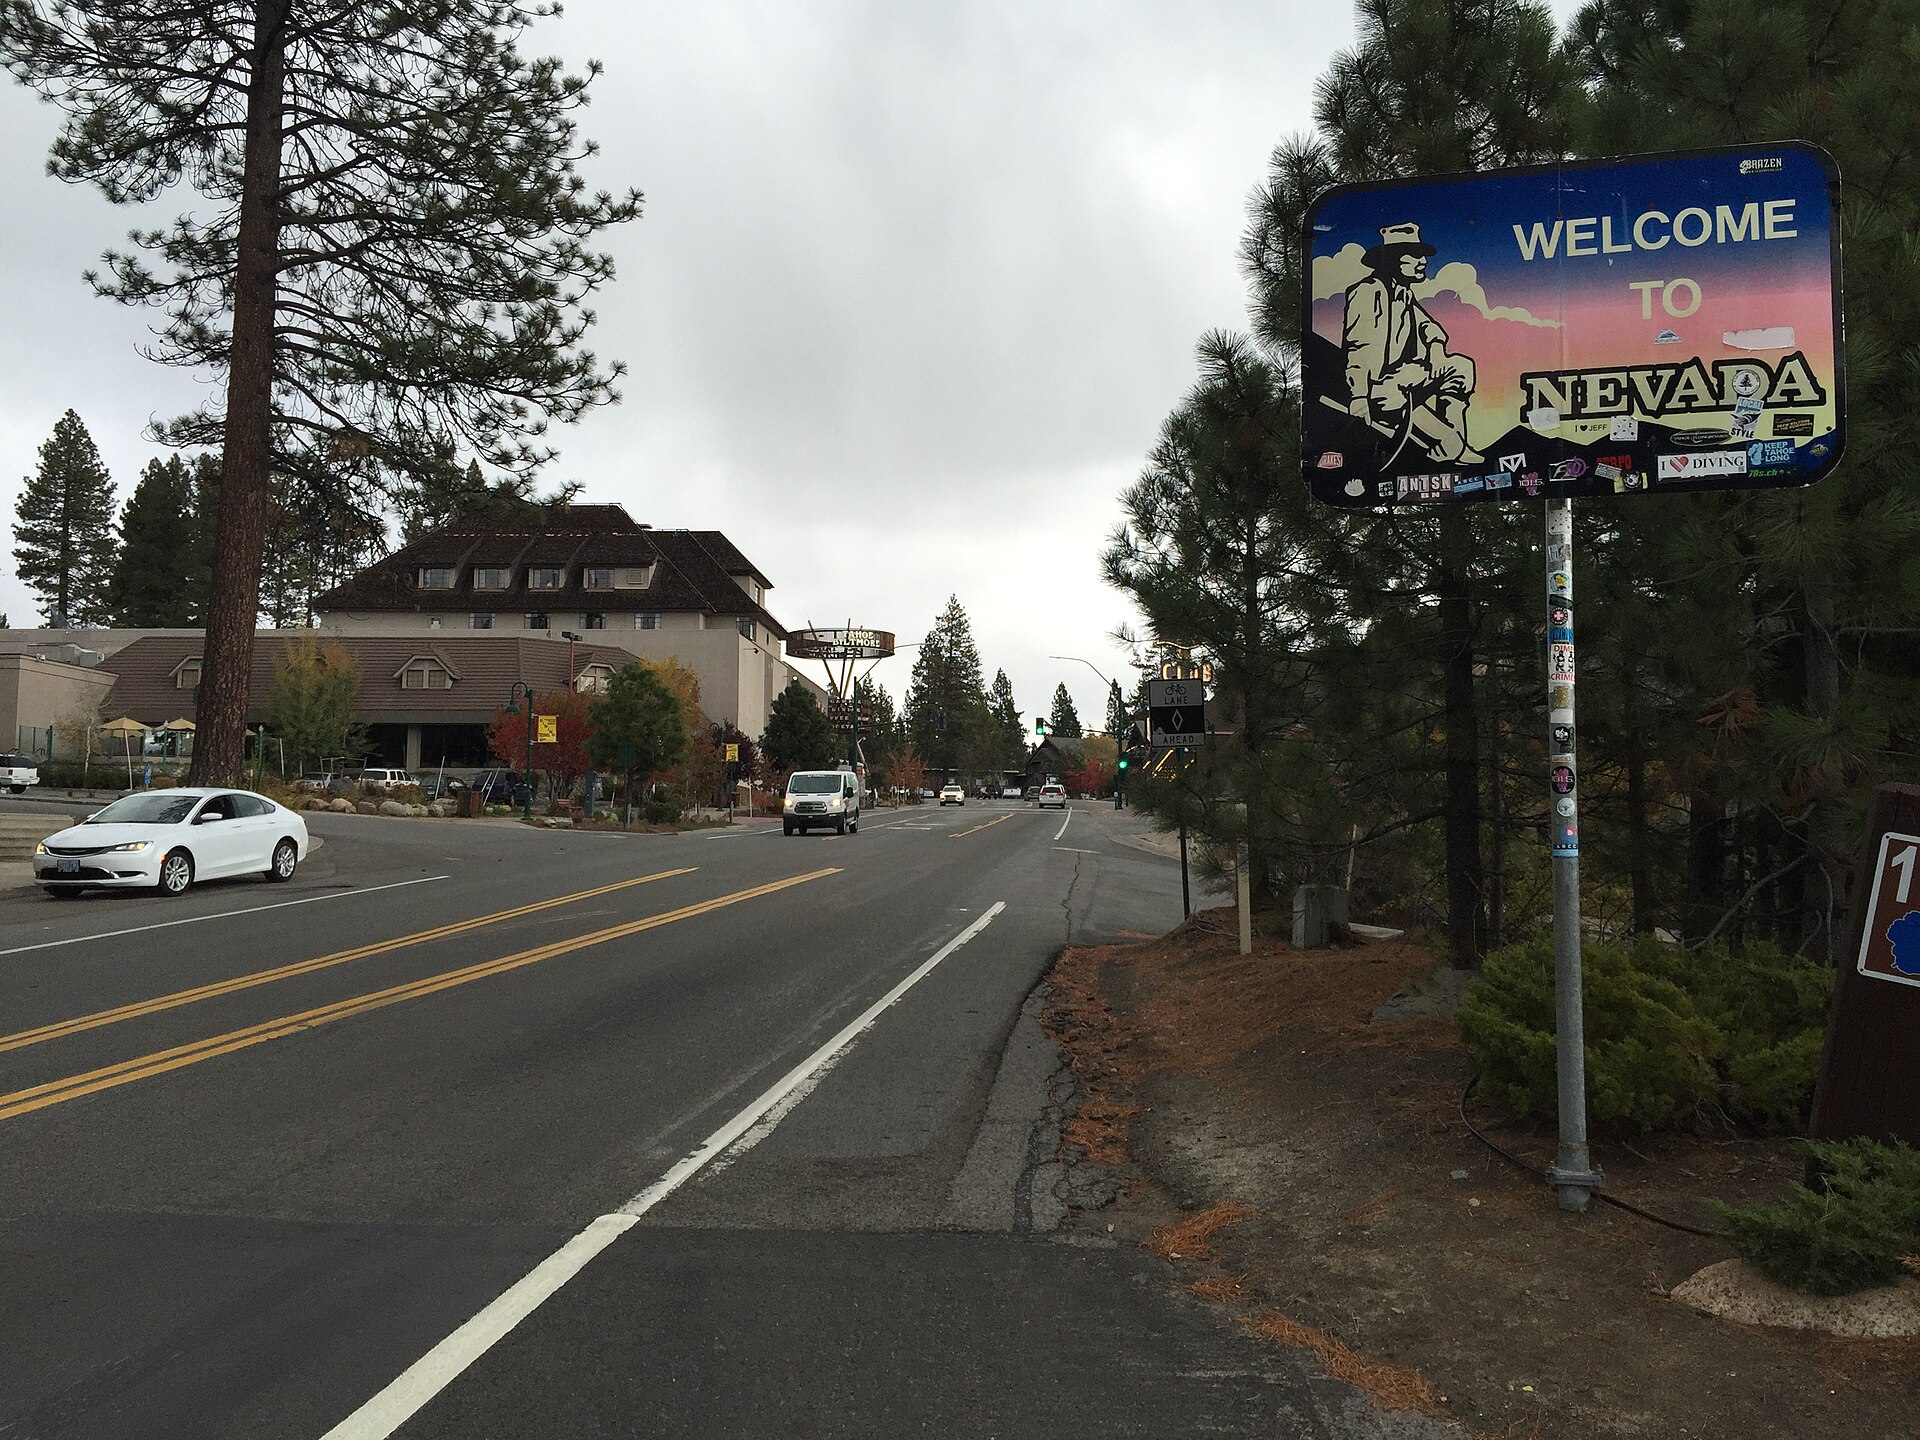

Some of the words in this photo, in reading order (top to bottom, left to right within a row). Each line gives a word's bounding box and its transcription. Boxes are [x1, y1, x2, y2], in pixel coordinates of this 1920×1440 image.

[1747, 157, 1782, 169] BRAZEN
[1512, 199, 1798, 261] WELCOME
[1628, 278, 1703, 320] TO
[1521, 352, 1826, 421] NEVADA
[1574, 424, 1578, 433] I
[1588, 424, 1608, 432] JEFF
[1730, 427, 1755, 439] STYLE
[1764, 441, 1788, 449] KEEP
[1764, 446, 1795, 456] TAHOE
[1661, 461, 1665, 470] I
[1693, 455, 1744, 469] DIVING
[1765, 454, 1790, 462] LONG
[841, 630, 874, 639] TAHOE
[832, 638, 881, 647] BILTMORE
[1164, 696, 1188, 705] LANE
[1162, 735, 1194, 744] AHEAD
